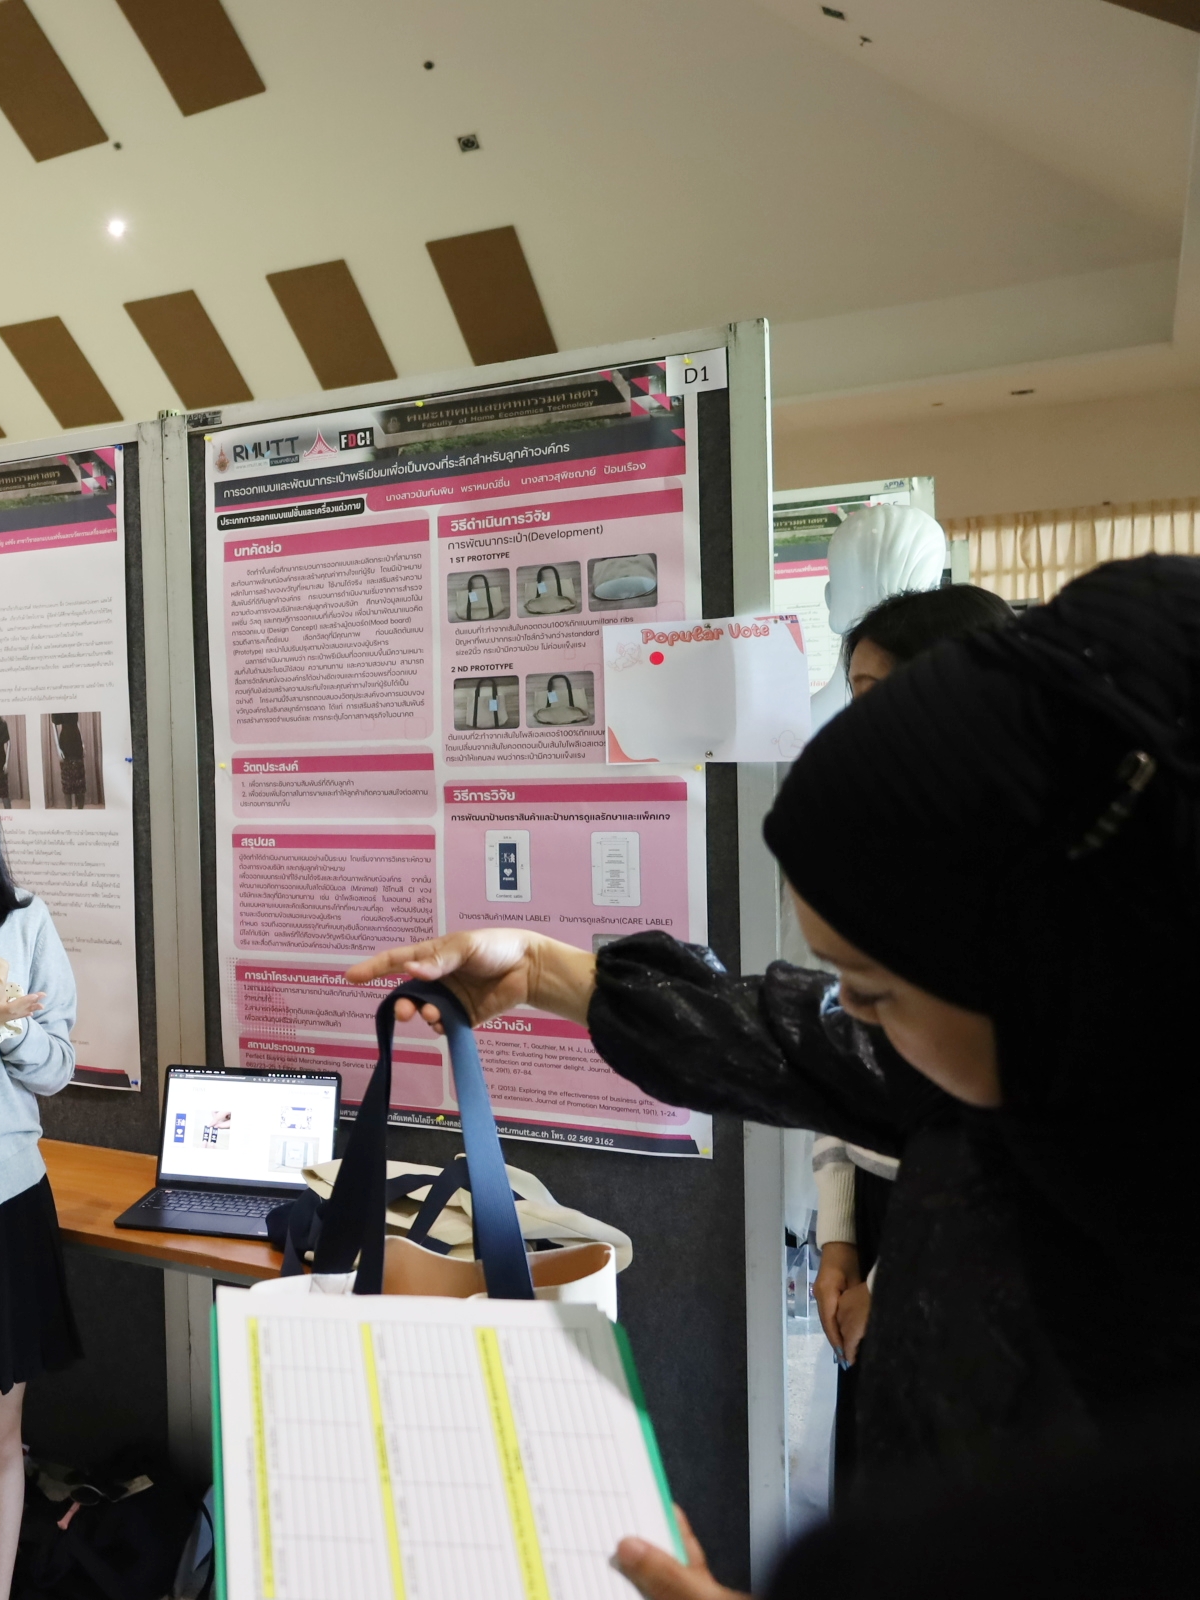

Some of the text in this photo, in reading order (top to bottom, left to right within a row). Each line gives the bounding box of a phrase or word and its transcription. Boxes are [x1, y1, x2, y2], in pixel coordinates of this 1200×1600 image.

[684, 366, 709, 384] D1
[340, 431, 371, 448] FDCI
[233, 436, 299, 463] RMUTT
[450, 510, 550, 532] วิธีดำเนินการวิจัย
[234, 543, 282, 557] บทคัดย่อ
[467, 552, 509, 561] PROTOTYPE
[641, 623, 769, 646] Popular Vote
[471, 663, 513, 671] PROTOTYPE
[244, 761, 298, 774] วัตถุประสงค์
[453, 789, 515, 801] วิธีการวิจัย
[241, 838, 275, 849] สรุปผล
[477, 1018, 531, 1032] ารอ้างอิง
[248, 1041, 315, 1054] สถานประกอบการ
[512, 1051, 543, 1059] Evaluating
[299, 1058, 340, 1067] Merchandising
[519, 1087, 546, 1096] Exploring
[560, 1091, 600, 1100] effectiveness
[610, 1096, 637, 1104] business
[567, 1101, 597, 1109] Promotion
[568, 1134, 576, 1142] 02
[579, 1135, 592, 1143] 549
[595, 1137, 613, 1145] 3162
